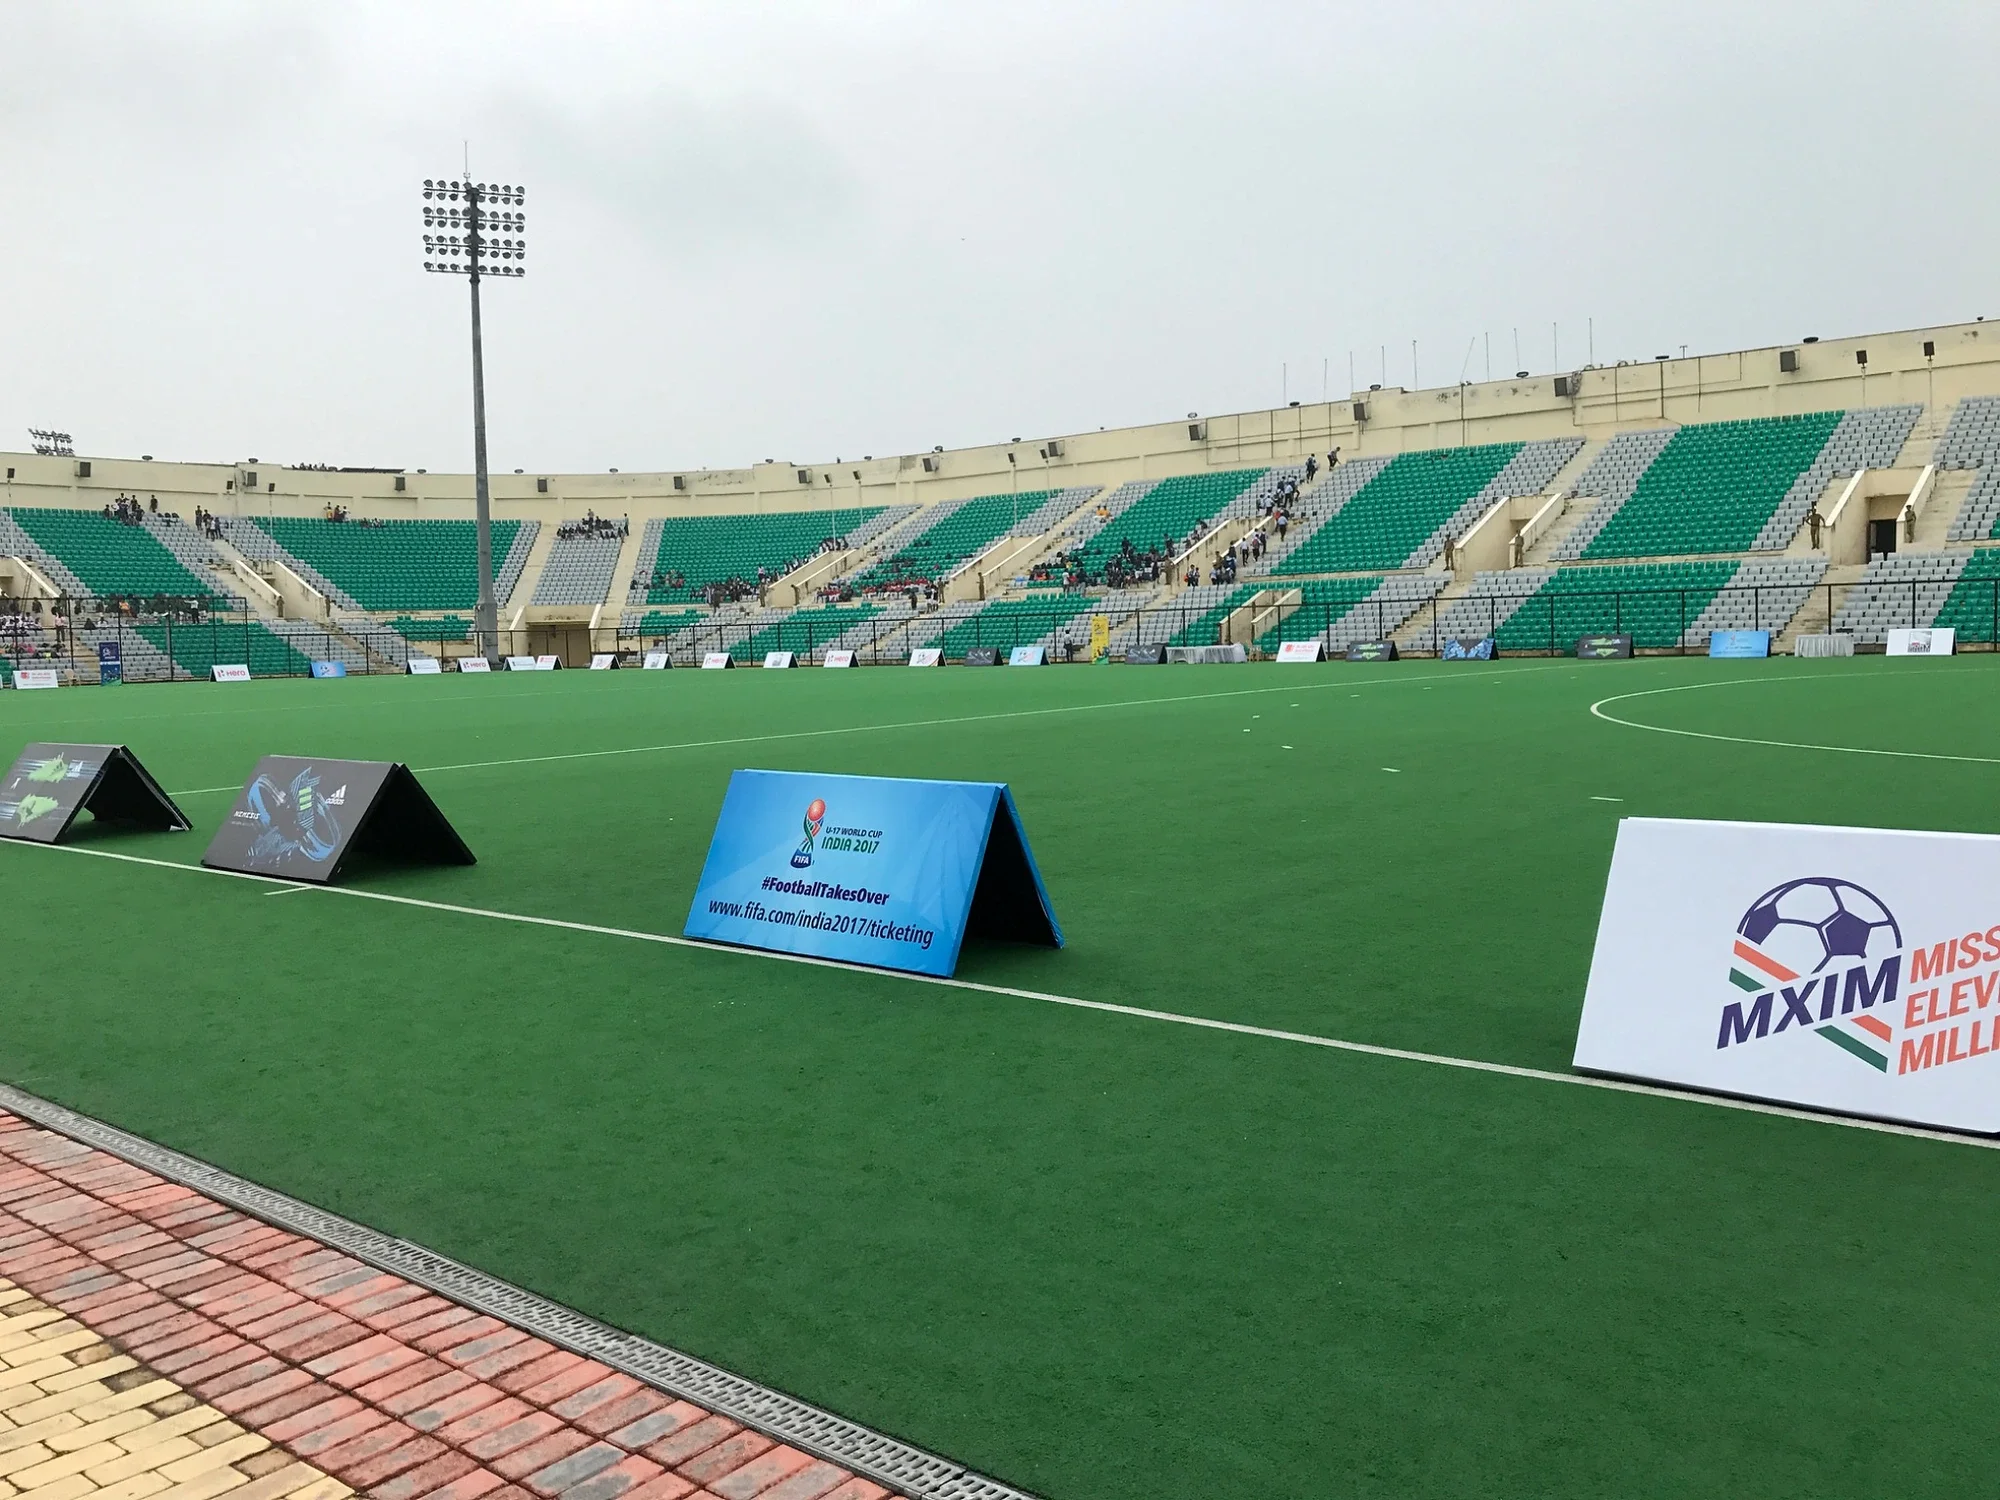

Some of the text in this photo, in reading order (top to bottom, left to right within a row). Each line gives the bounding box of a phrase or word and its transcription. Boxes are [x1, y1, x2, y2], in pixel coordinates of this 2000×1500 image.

[821, 836, 880, 854] INDIA 2017
[825, 826, 883, 838] U-17 WORLD CUP
[793, 855, 809, 865] FIFA
[761, 876, 890, 906] #FootballTakesOver
[708, 899, 935, 950] www.fifa.com/india2017/ticketing
[1717, 954, 1903, 1050] MXIM
[1904, 969, 2000, 1030] ELEV
